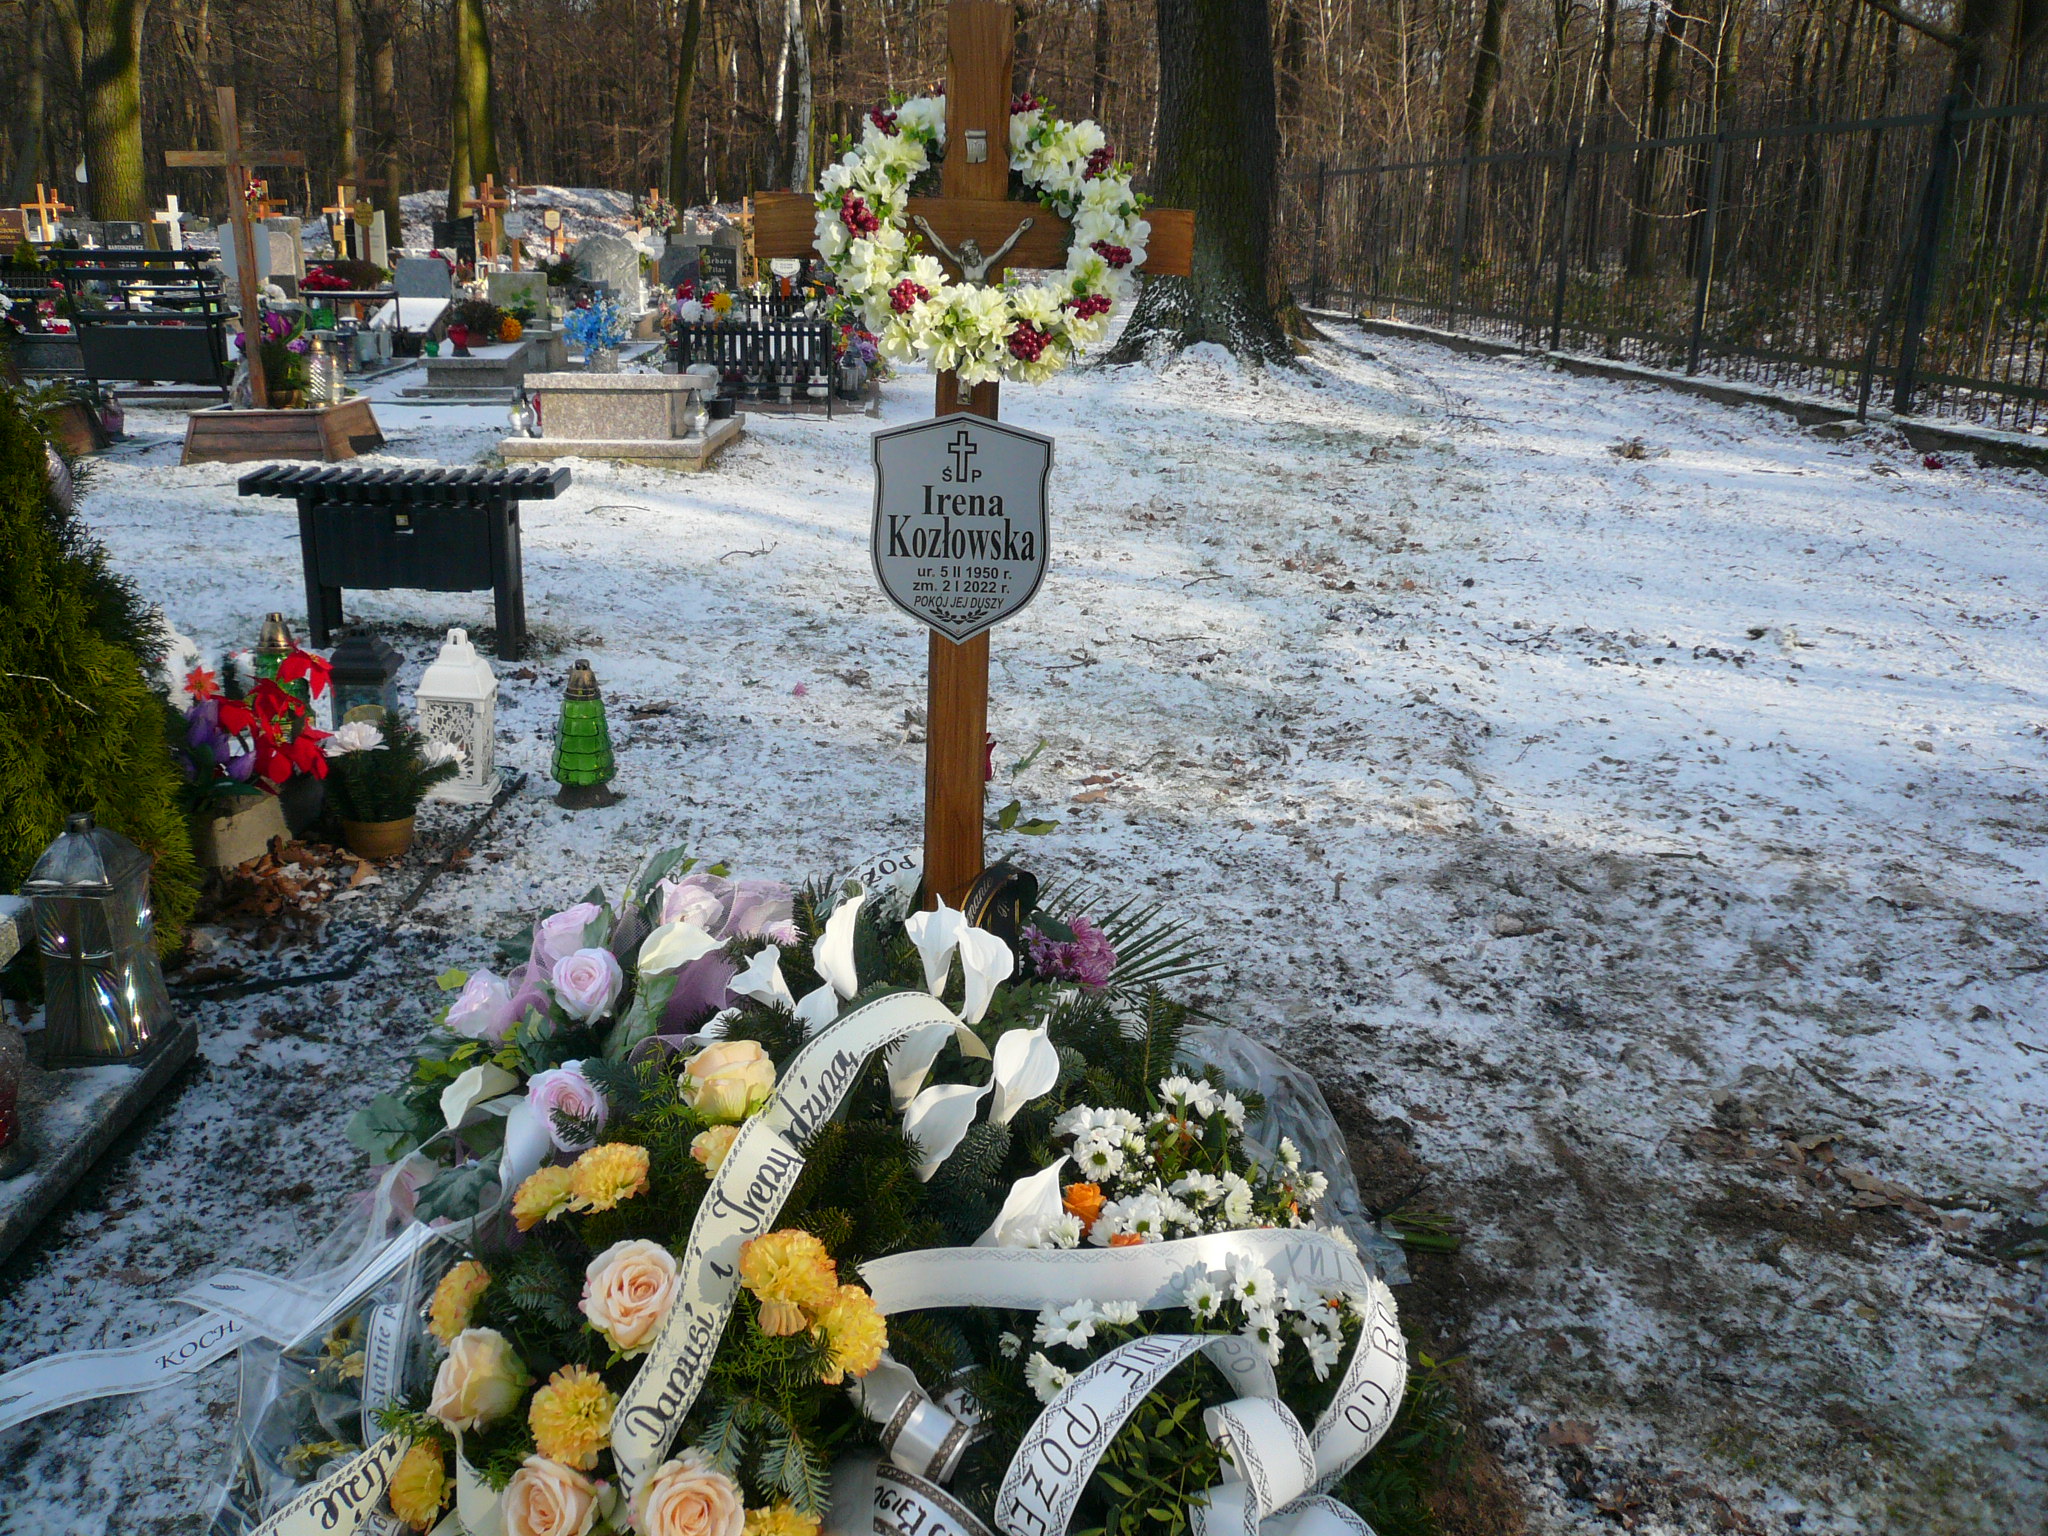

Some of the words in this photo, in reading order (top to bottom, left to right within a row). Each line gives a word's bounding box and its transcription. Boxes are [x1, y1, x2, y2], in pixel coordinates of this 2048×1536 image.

[972, 469, 982, 483] P
[922, 485, 1004, 517] Irena
[888, 515, 1036, 561] Kozłowska
[917, 567, 936, 578] ur.
[940, 566, 949, 578] 5
[952, 565, 961, 578] II
[966, 566, 999, 579] 1950
[1003, 569, 1013, 580] r.
[912, 581, 938, 592] zm.
[942, 580, 951, 592] 2
[954, 580, 960, 592] I
[964, 581, 997, 593] 2022
[1001, 583, 1011, 594] r.
[913, 593, 949, 608] POKÓJ
[949, 596, 969, 609] JEJ
[969, 597, 1004, 610] DUSZY
[625, 1302, 714, 1448] Danusi
[713, 1147, 802, 1233] Ireny
[1345, 1380, 1391, 1432] OD
